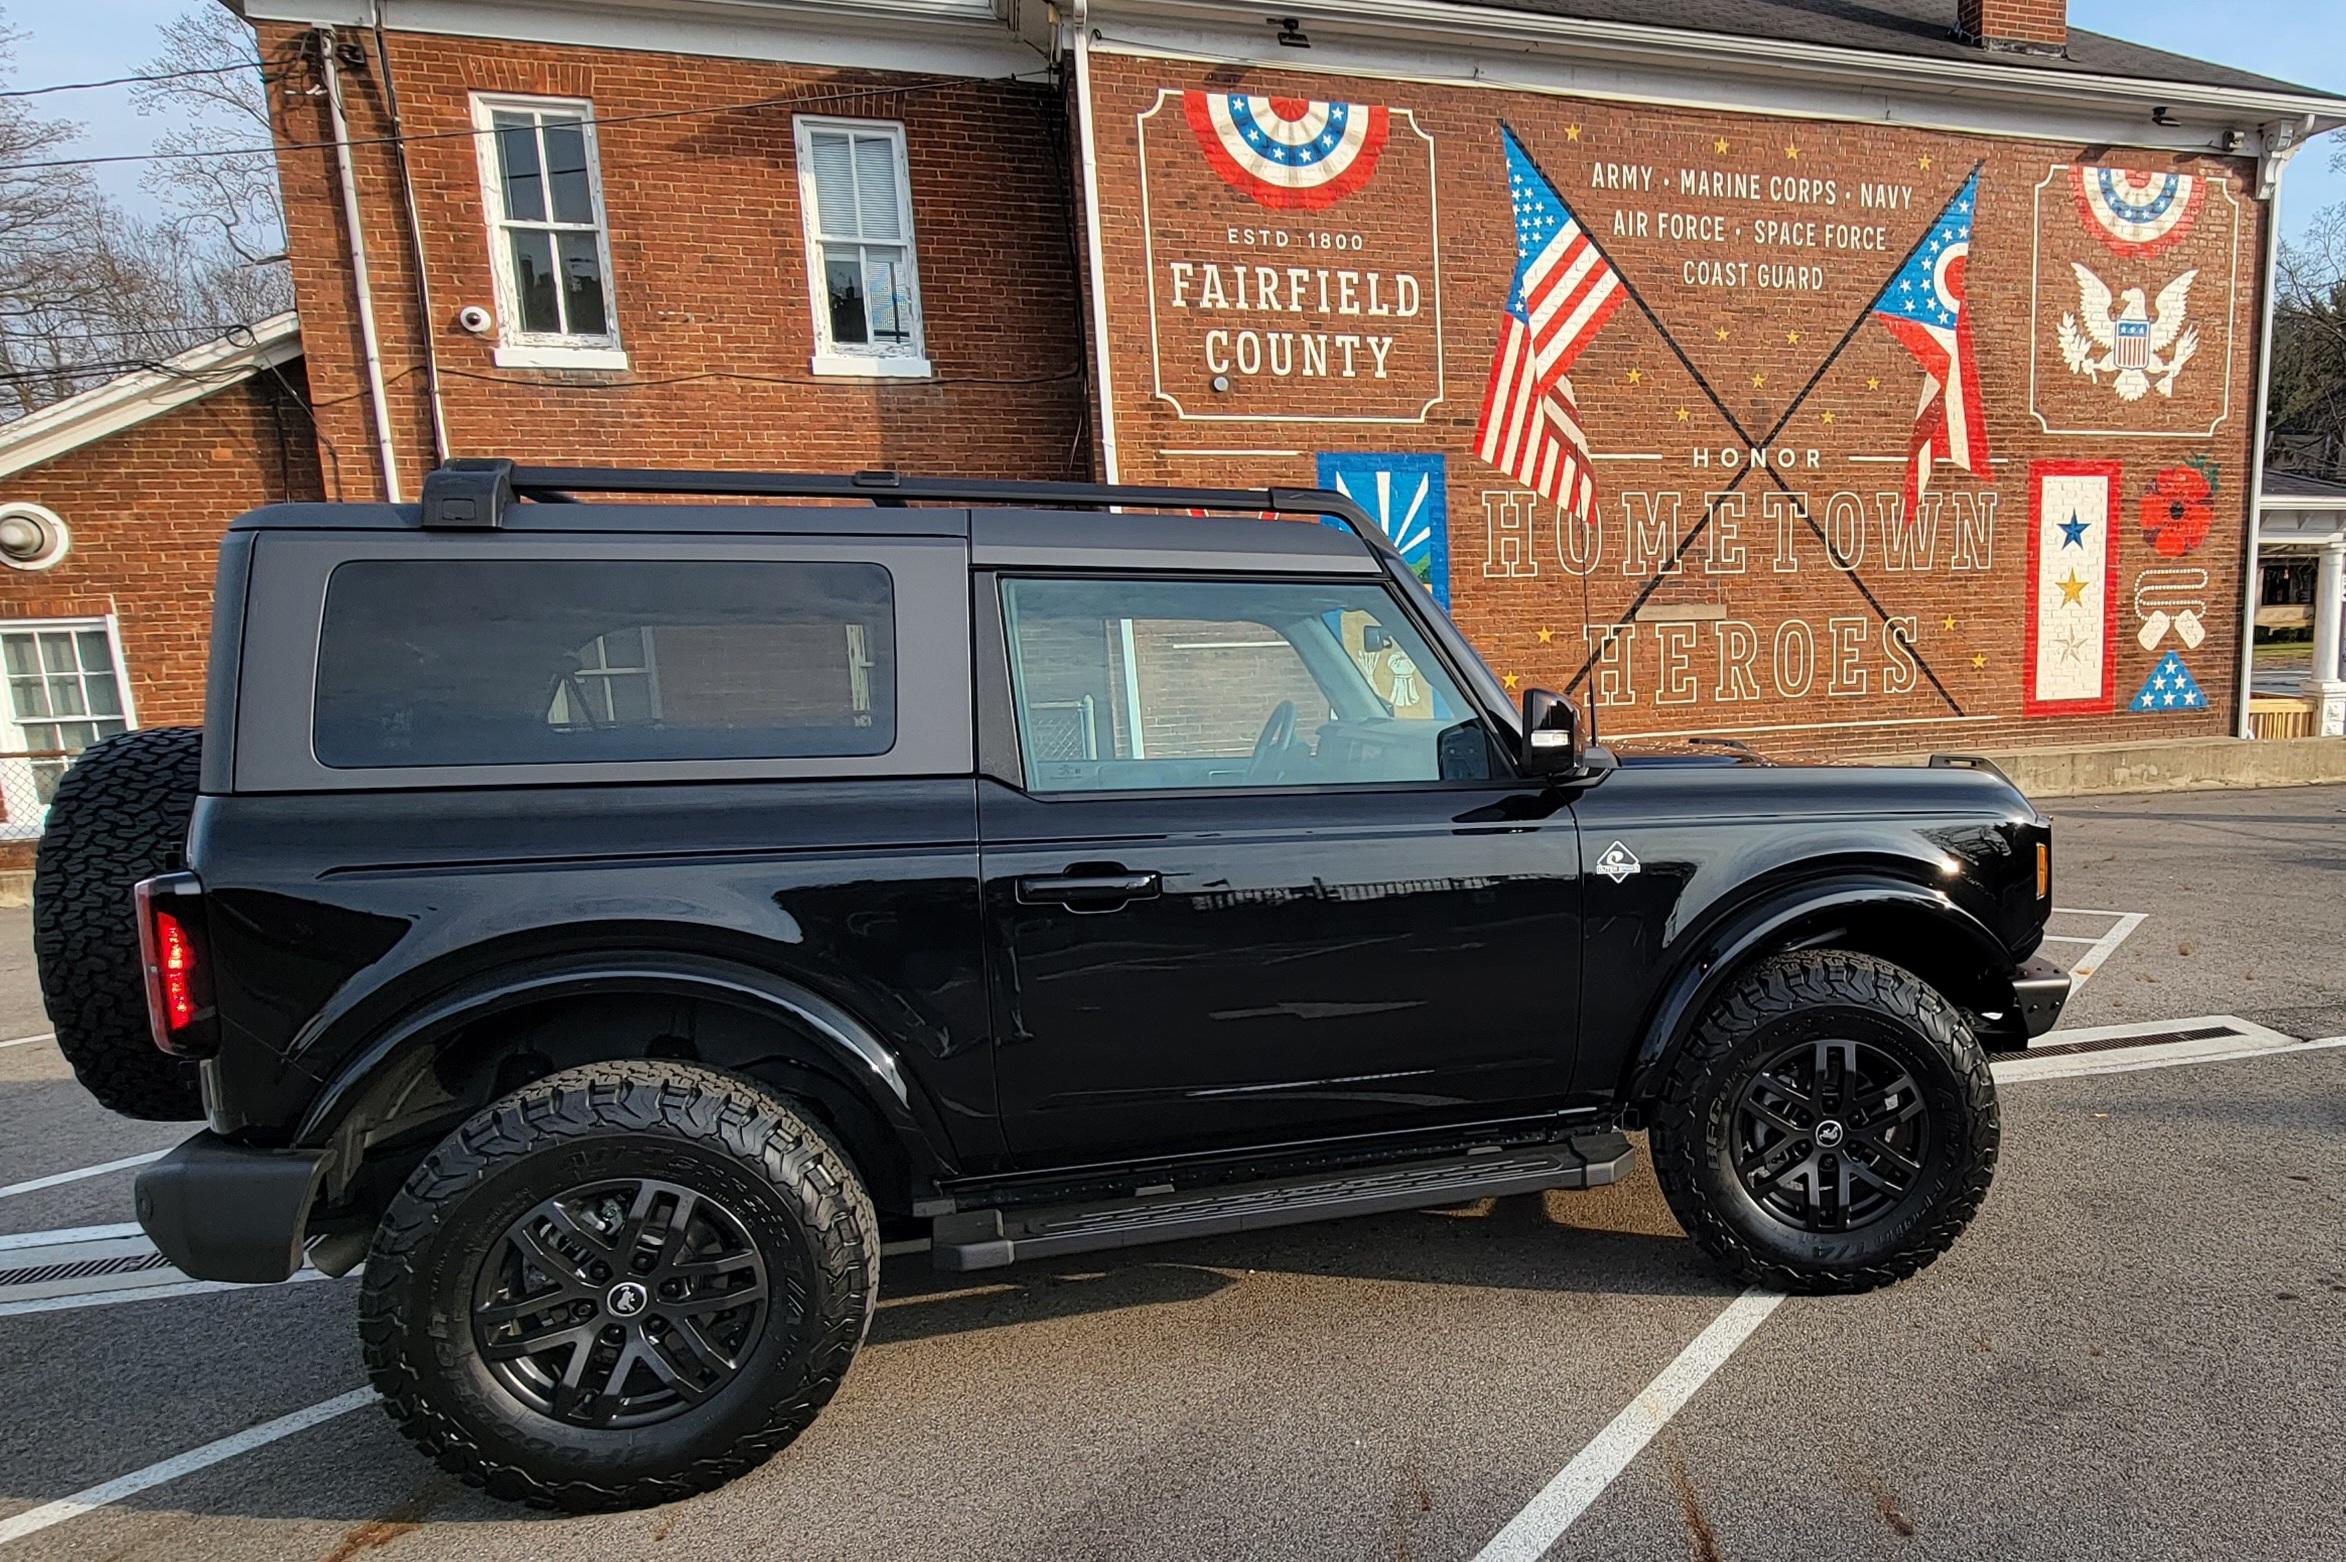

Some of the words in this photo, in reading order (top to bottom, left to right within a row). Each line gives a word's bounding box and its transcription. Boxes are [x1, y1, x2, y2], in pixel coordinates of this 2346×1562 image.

[1591, 161, 1653, 192] ARMY
[1680, 168, 1761, 200] MARINE
[1769, 175, 1837, 206] CORPS
[1860, 182, 1913, 210] NAVY
[1227, 228, 1289, 248] ESTD
[1307, 232, 1363, 250] 1800
[1613, 209, 1649, 238] AIR
[1657, 212, 1725, 242] FORCE
[1754, 219, 1816, 247] SPACE
[1825, 224, 1886, 251] FORCE
[1169, 262, 1420, 318] FAIRFIELD
[1683, 260, 1749, 288] COAST
[1757, 263, 1824, 291] GUARD
[1205, 330, 1393, 379] COUNTY
[1692, 447, 1821, 469] HONOR
[1481, 490, 1998, 579] HOMETOWN
[1583, 615, 1918, 708] HEROES
